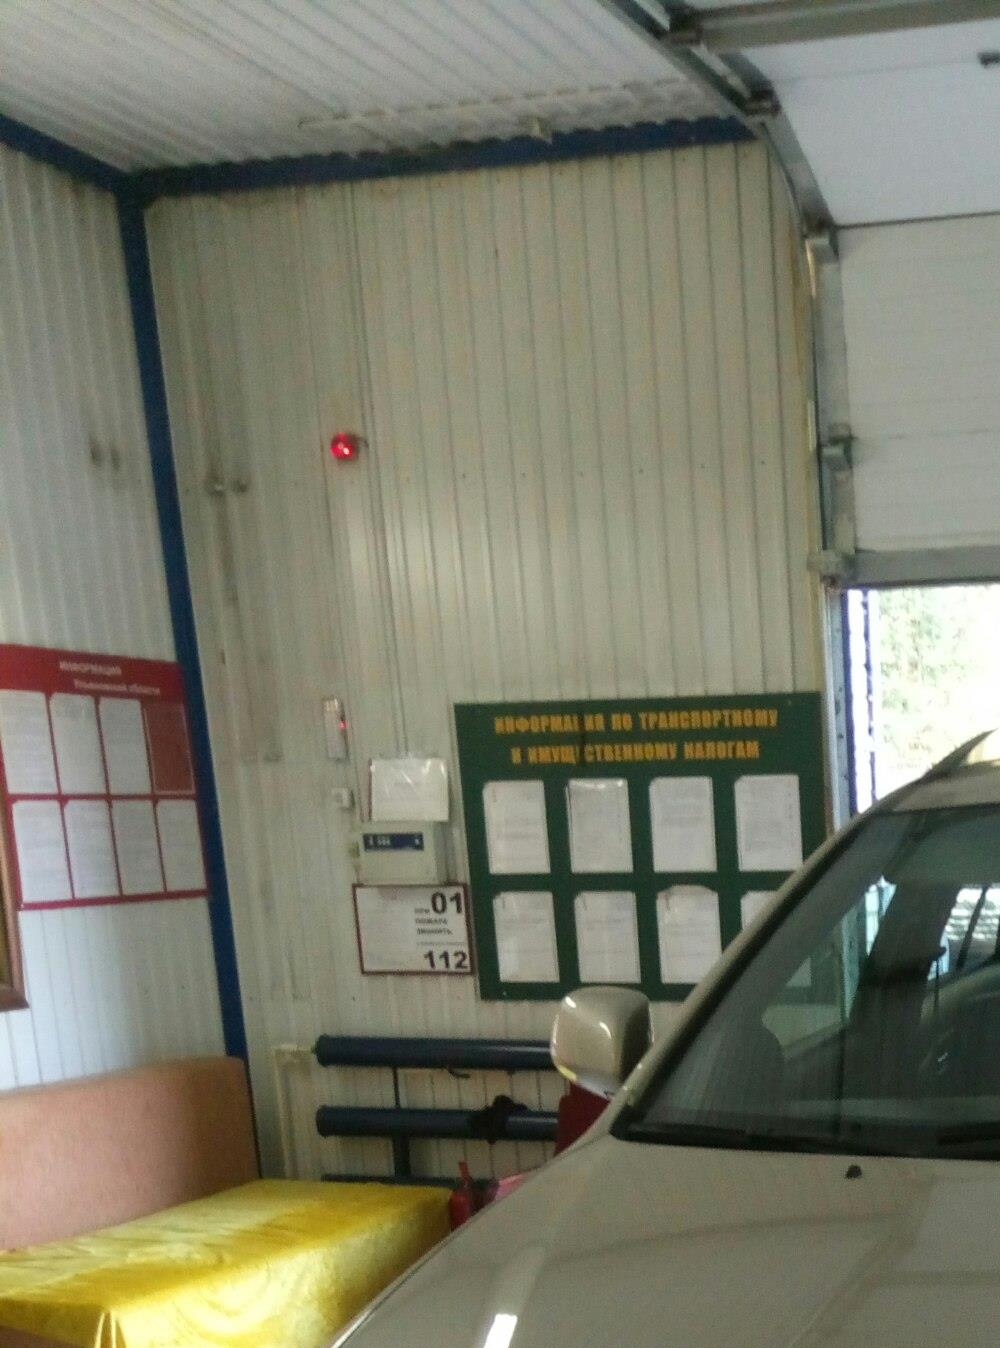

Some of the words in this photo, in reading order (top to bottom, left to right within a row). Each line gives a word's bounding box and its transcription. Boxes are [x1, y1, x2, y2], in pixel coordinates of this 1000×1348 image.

[612, 712, 633, 732] ПО
[639, 708, 778, 731] ТРАНСПОРТНОМУ
[683, 740, 760, 760] НАЛОГАМ
[431, 892, 463, 914] 01
[424, 950, 469, 970] 112
